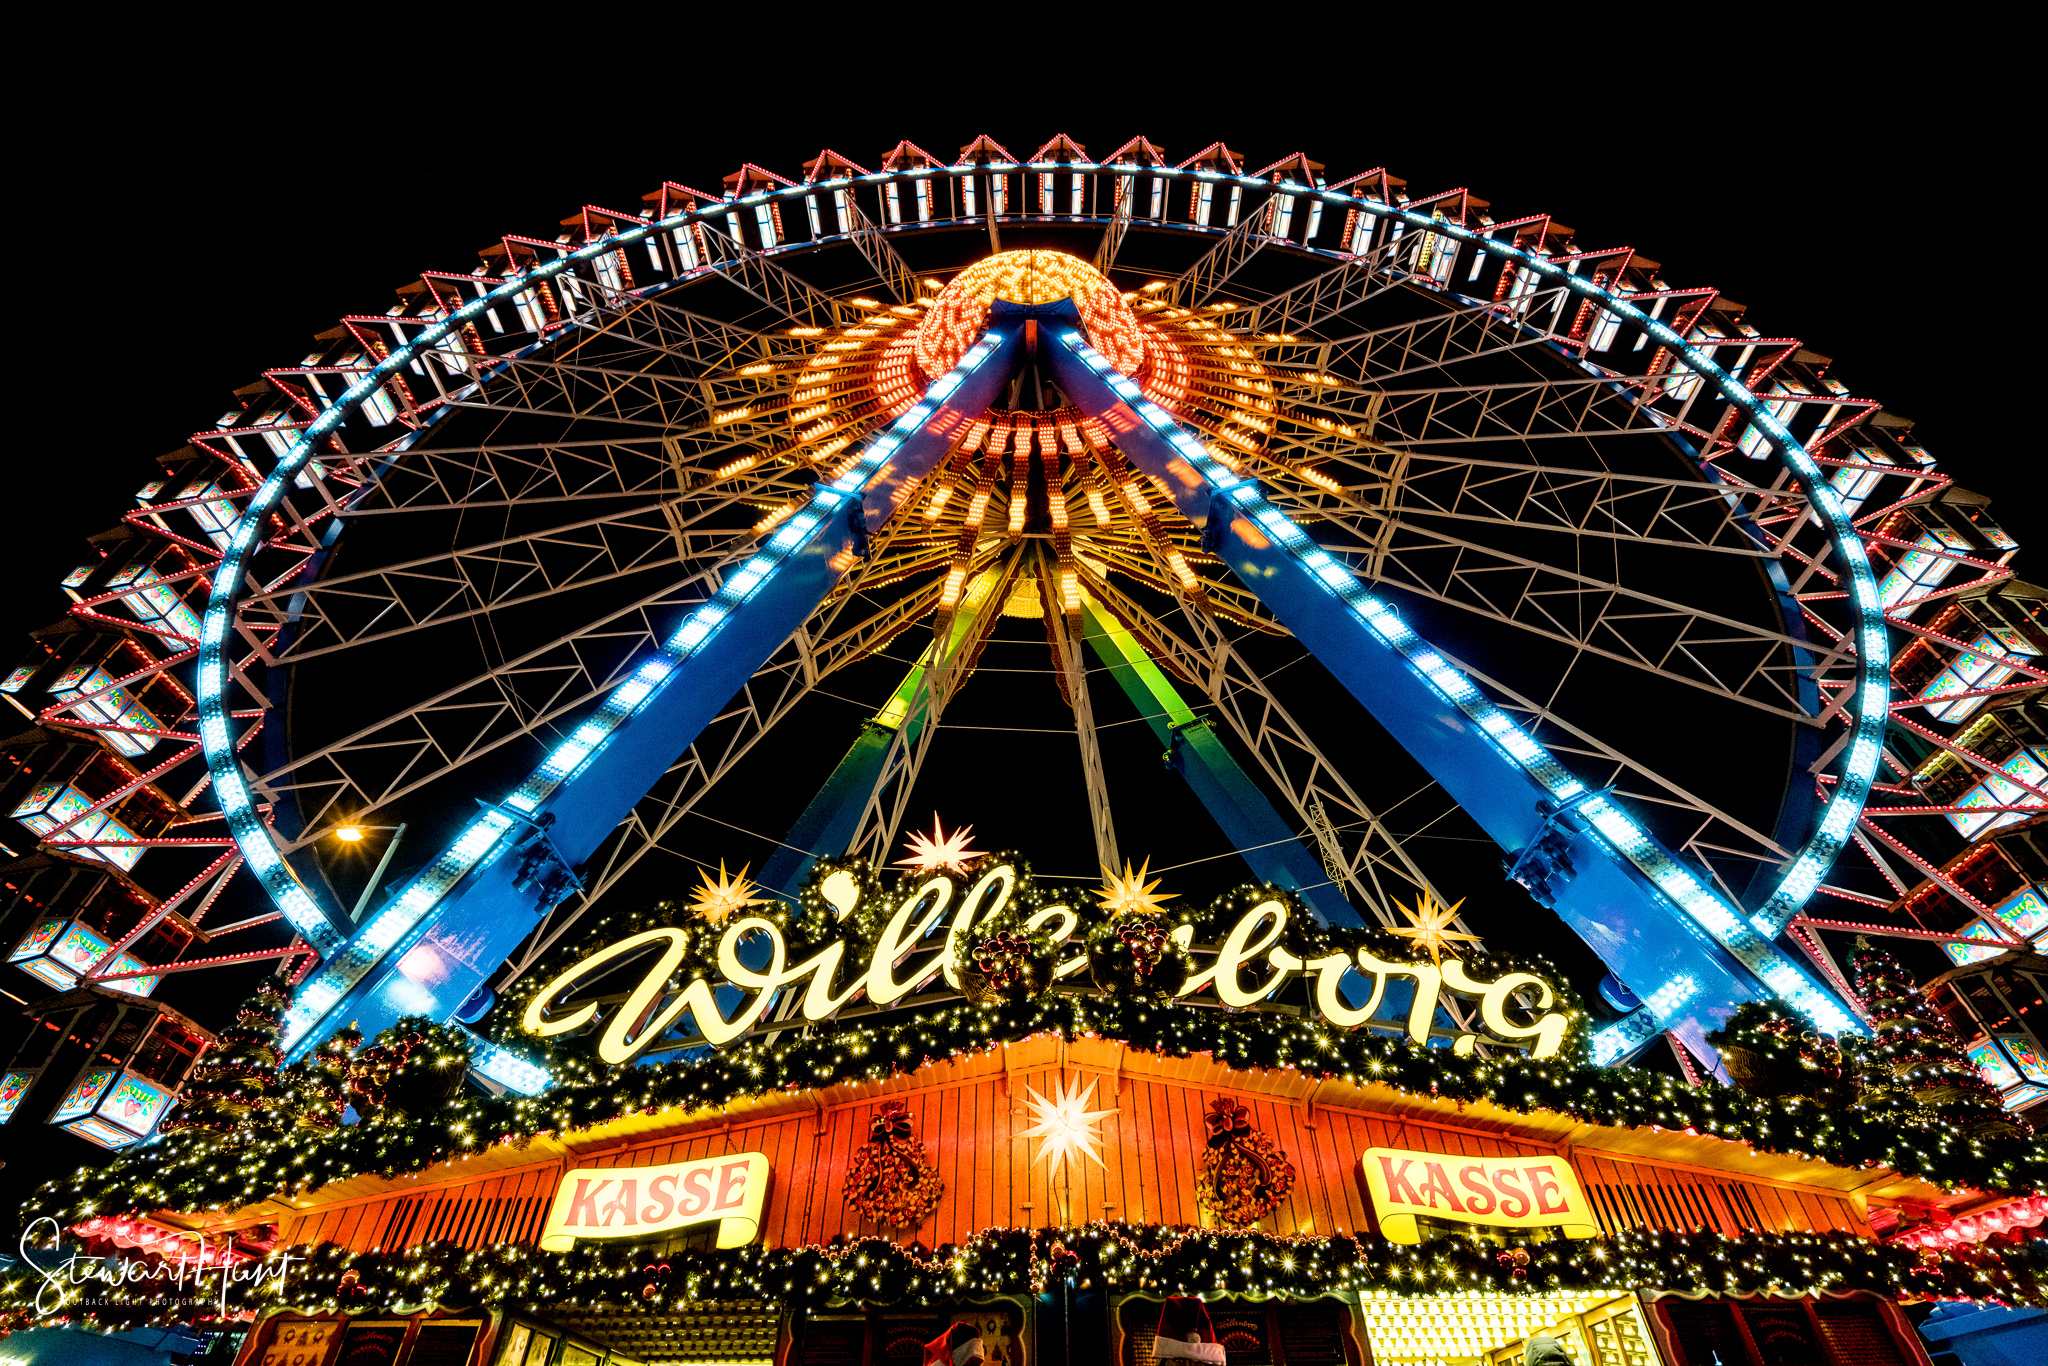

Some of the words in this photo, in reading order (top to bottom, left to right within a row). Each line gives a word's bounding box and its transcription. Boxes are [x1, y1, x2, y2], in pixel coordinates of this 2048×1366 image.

[563, 1160, 750, 1227] KASSE
[1377, 1156, 1570, 1218] KASSE
[1216, 1318, 1258, 1331] Willenborg
